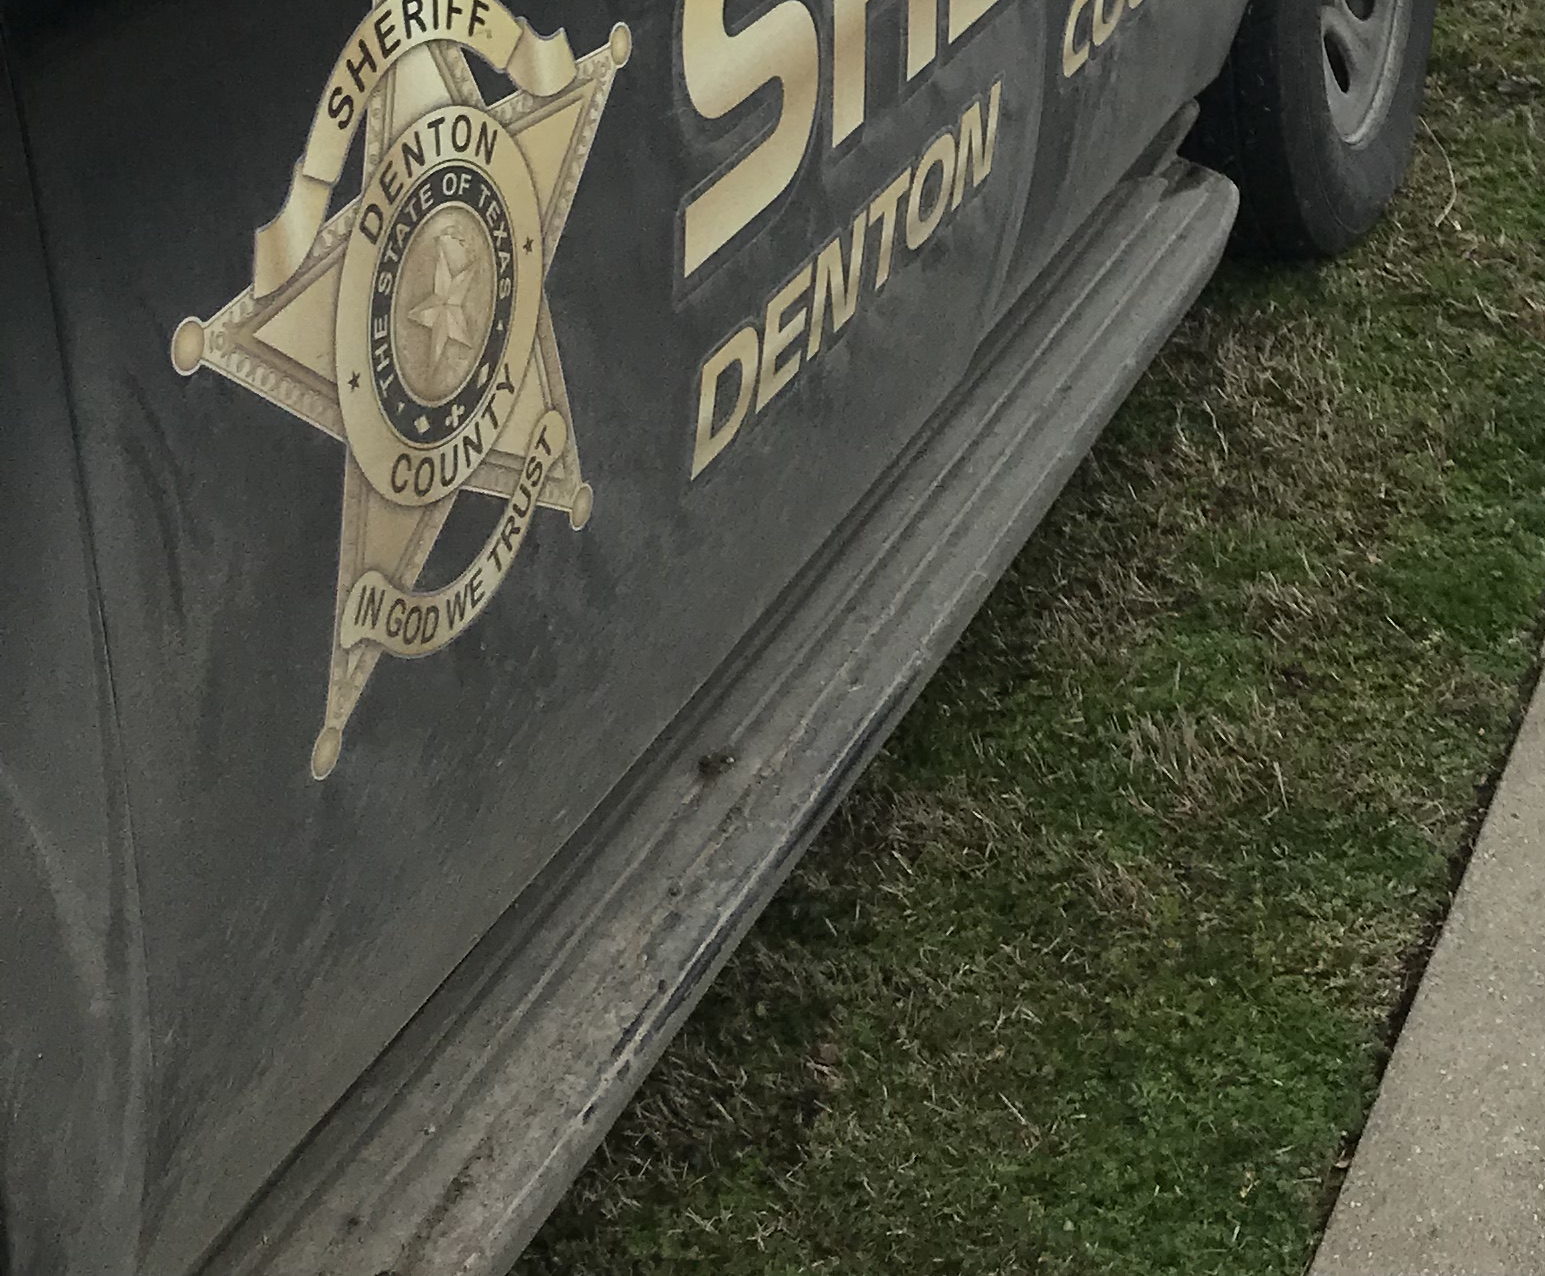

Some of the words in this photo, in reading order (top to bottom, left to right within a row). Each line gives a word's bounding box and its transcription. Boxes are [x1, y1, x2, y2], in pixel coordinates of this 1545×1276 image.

[359, 114, 498, 245] DENTON
[377, 183, 434, 296] STATE
[442, 172, 472, 196] OF
[478, 184, 512, 300] TEXAS
[691, 79, 1001, 480] DENTON
[373, 315, 395, 398] THE
[390, 363, 515, 498] COUNTY
[354, 584, 385, 630] IN
[386, 598, 440, 645] GOD
[446, 568, 485, 631] WE
[487, 425, 552, 574] TRUST
